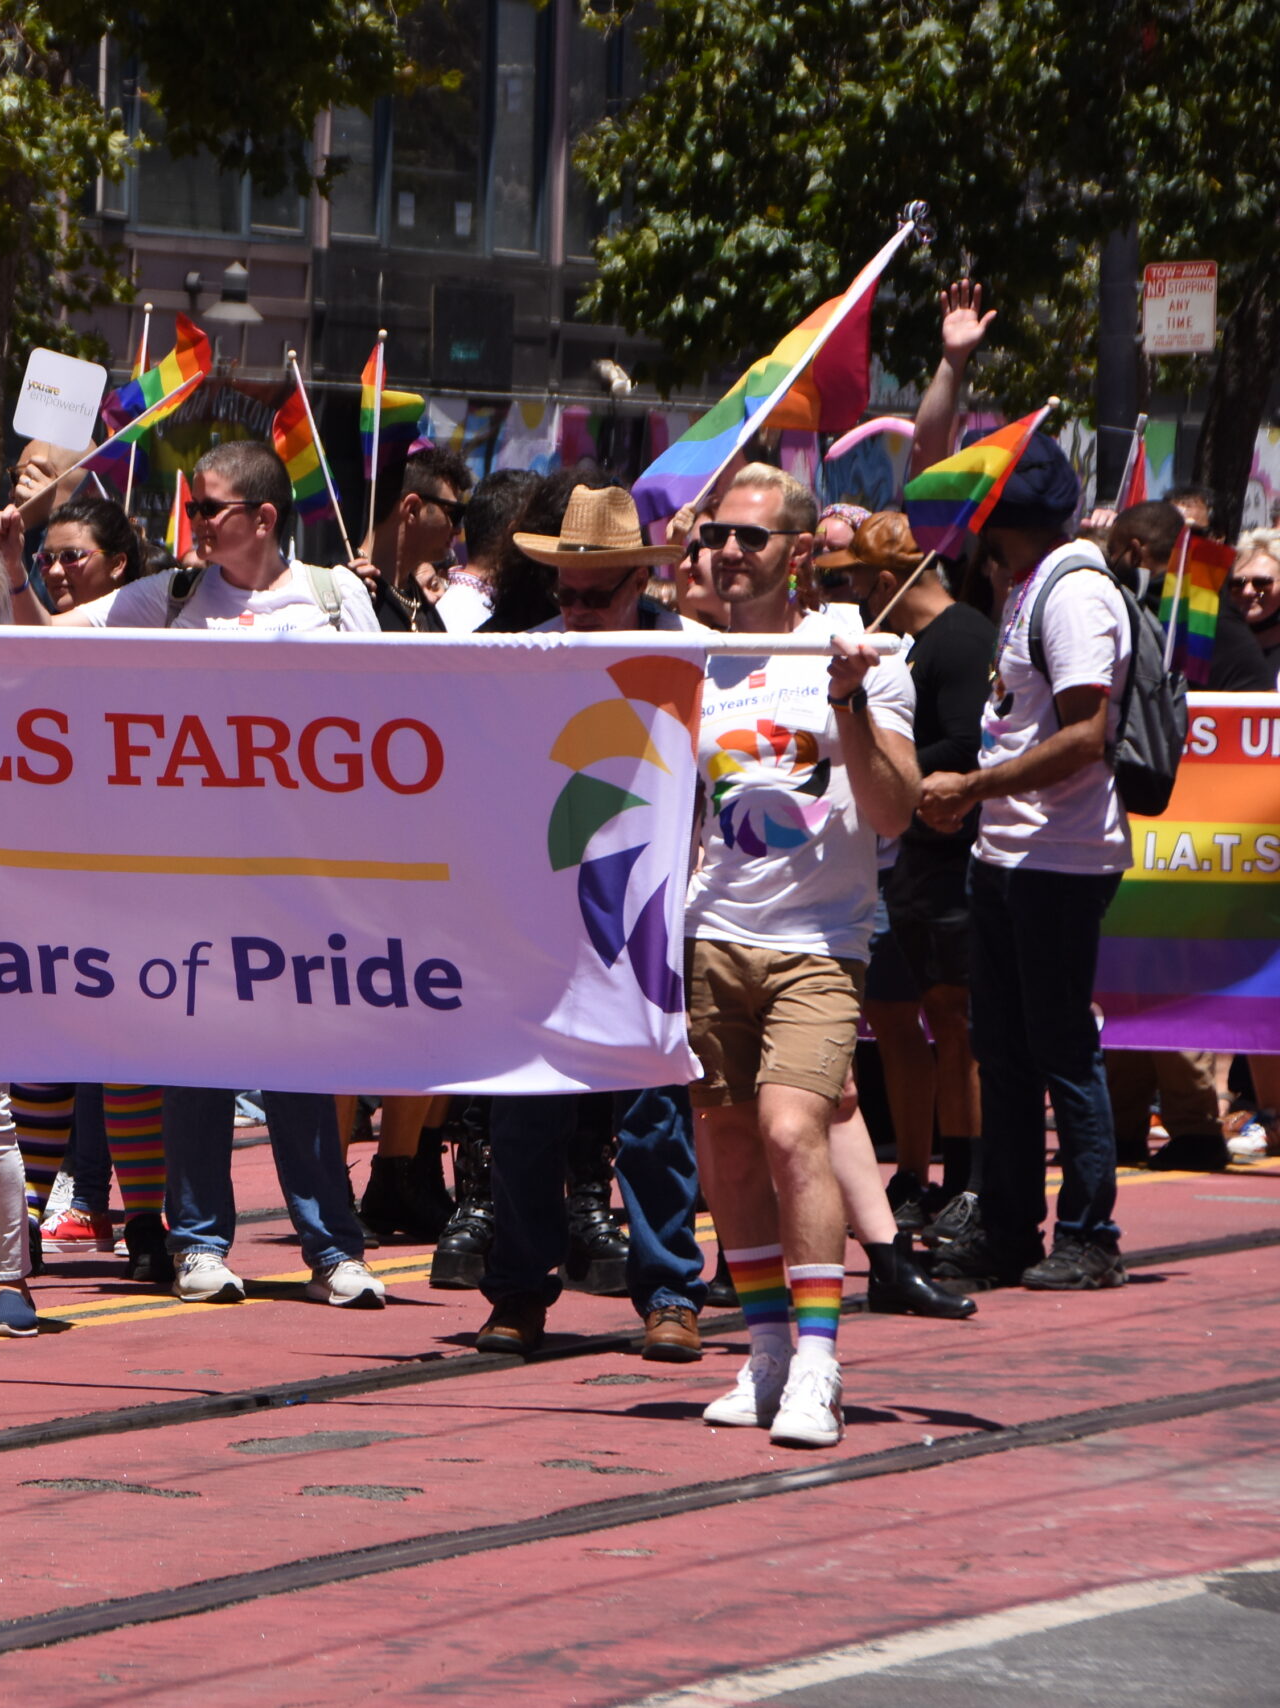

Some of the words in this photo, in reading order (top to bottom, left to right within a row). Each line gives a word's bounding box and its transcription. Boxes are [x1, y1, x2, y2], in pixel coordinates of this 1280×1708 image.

[1152, 265, 1210, 278] TOW-AWAY
[1147, 280, 1166, 297] NO
[1167, 279, 1215, 295] STOPPING
[1169, 300, 1190, 312] ANY
[1168, 316, 1192, 329] TIME
[30, 391, 96, 417] empowerful
[719, 695, 758, 711] Years
[105, 712, 444, 795] FARGO
[139, 941, 213, 1016] of
[232, 933, 463, 1011] Pride
